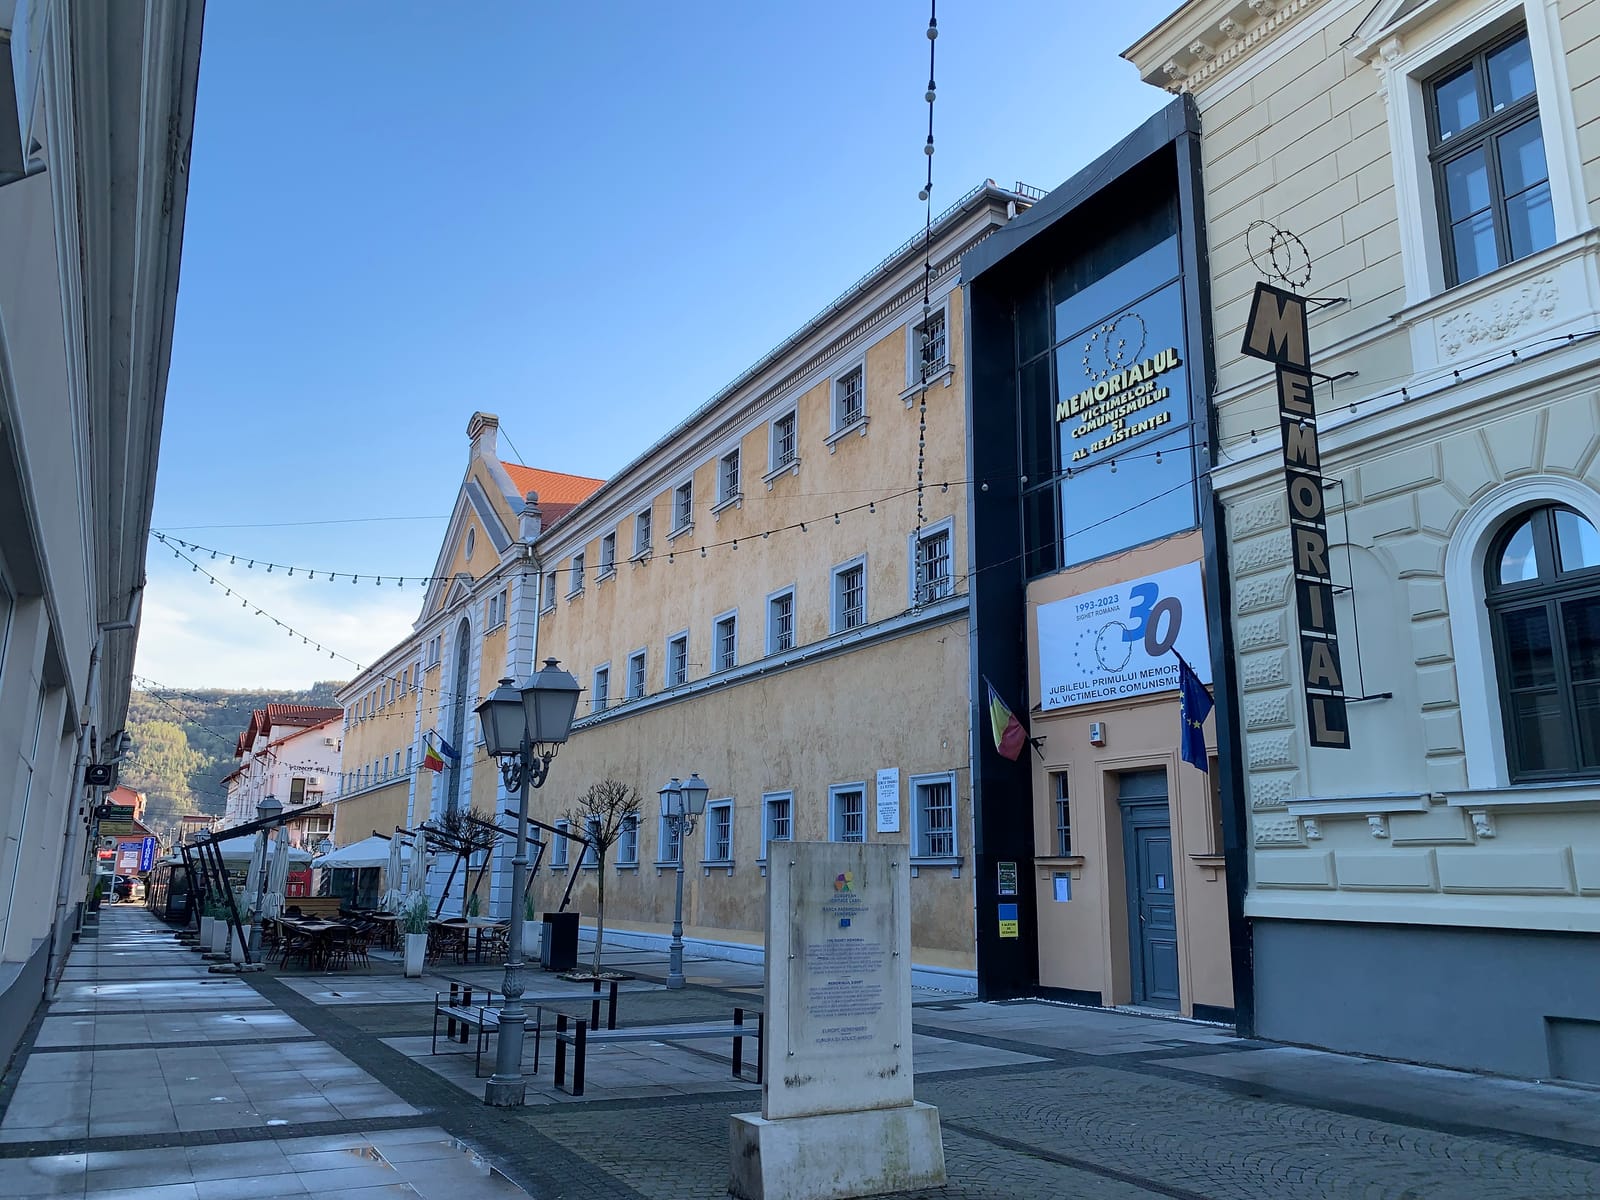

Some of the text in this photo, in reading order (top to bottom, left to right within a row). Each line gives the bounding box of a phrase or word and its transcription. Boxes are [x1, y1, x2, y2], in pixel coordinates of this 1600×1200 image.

[1056, 347, 1181, 422] MEMORIALUL
[1082, 381, 1157, 422] VICTIMELOR
[1072, 387, 1168, 438] COMUNISMULUI
[1072, 447, 1087, 461] AL
[1249, 290, 1345, 744] MEMORIAL
[1075, 594, 1120, 614] 1993-2023
[1076, 611, 1095, 622] SIGHET
[1121, 582, 1182, 657] 30
[1049, 662, 1196, 695] JUBILEUL PRIMULUI MEMORL
[1049, 696, 1061, 705] AL
[1063, 685, 1118, 703] VICTIMELOR
